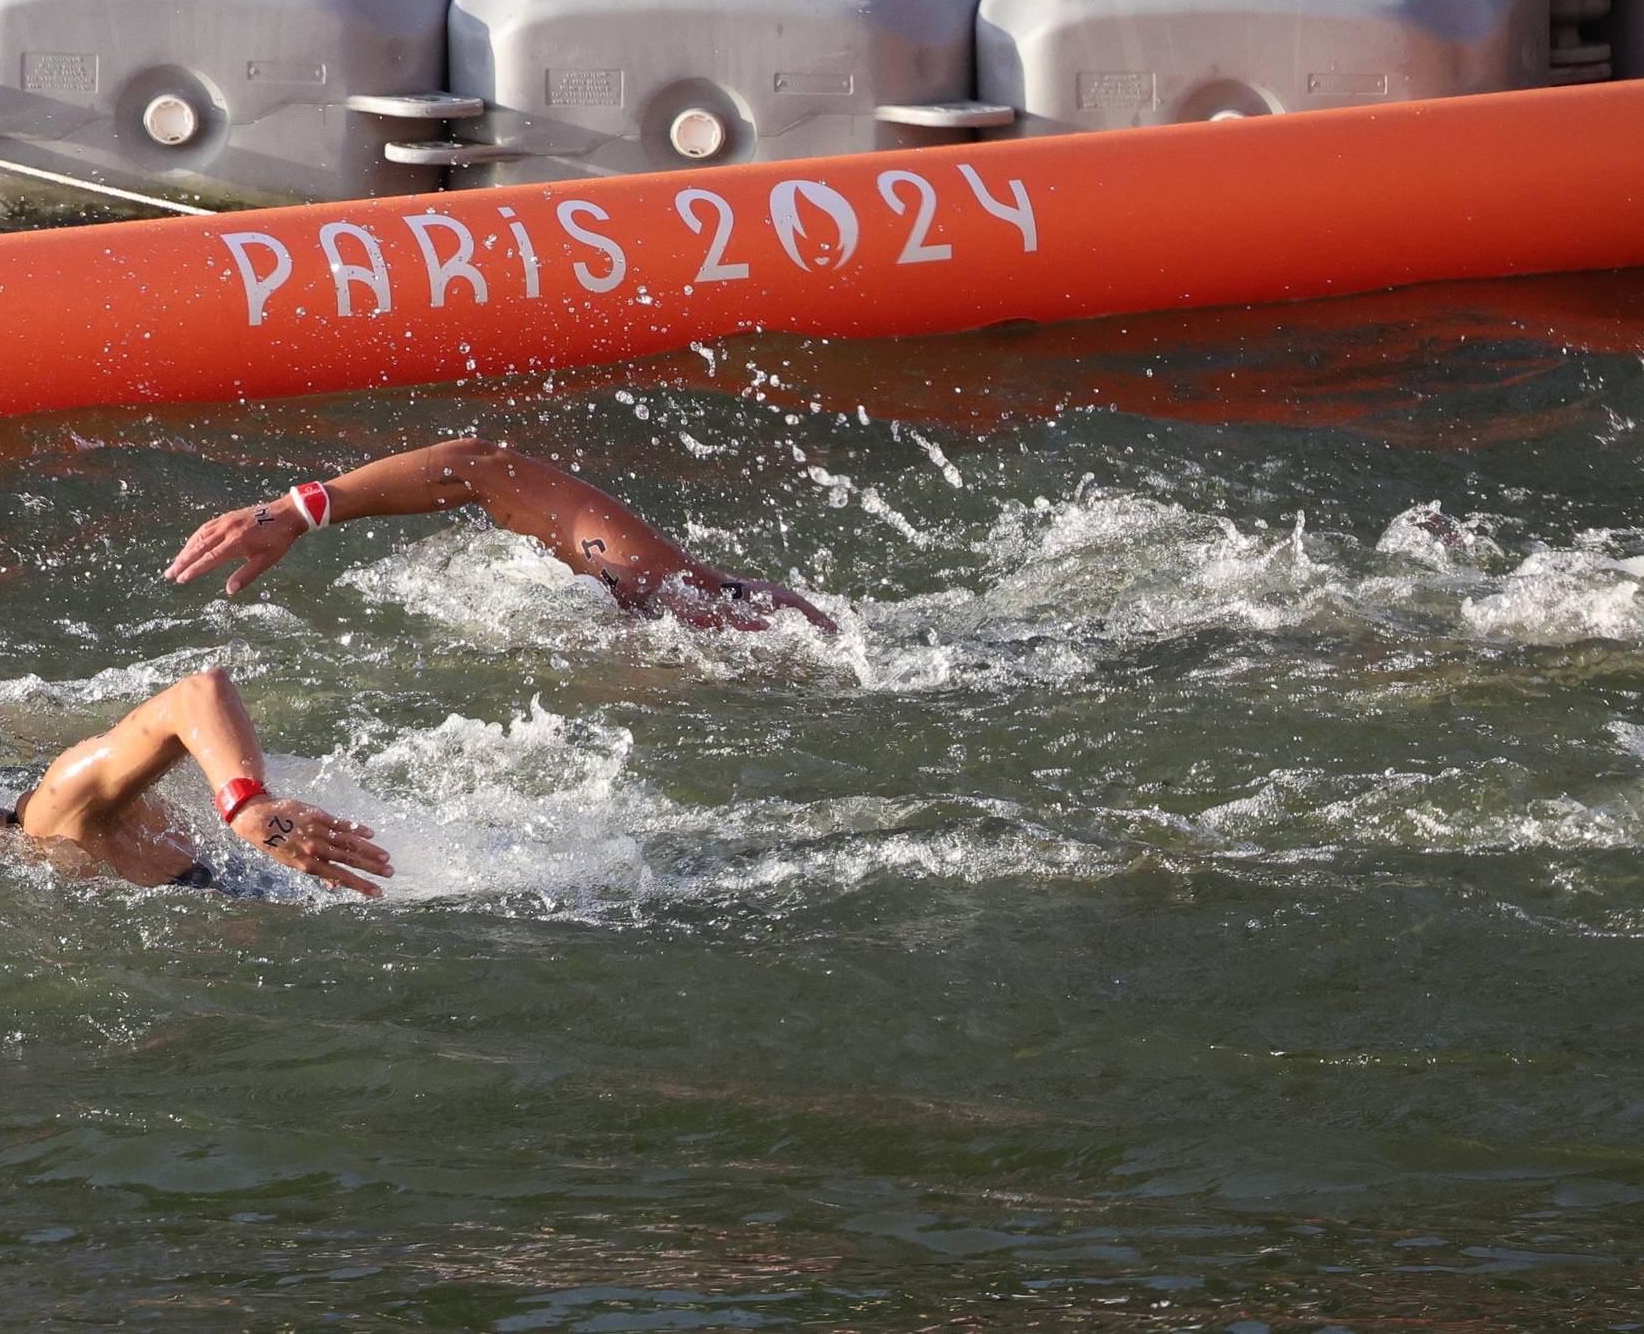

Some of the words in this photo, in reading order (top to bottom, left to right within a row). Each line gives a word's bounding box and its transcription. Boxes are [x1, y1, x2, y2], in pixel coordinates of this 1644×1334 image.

[221, 199, 626, 326] PARIS
[675, 164, 1036, 282] 2024
[263, 815, 295, 848] 24
